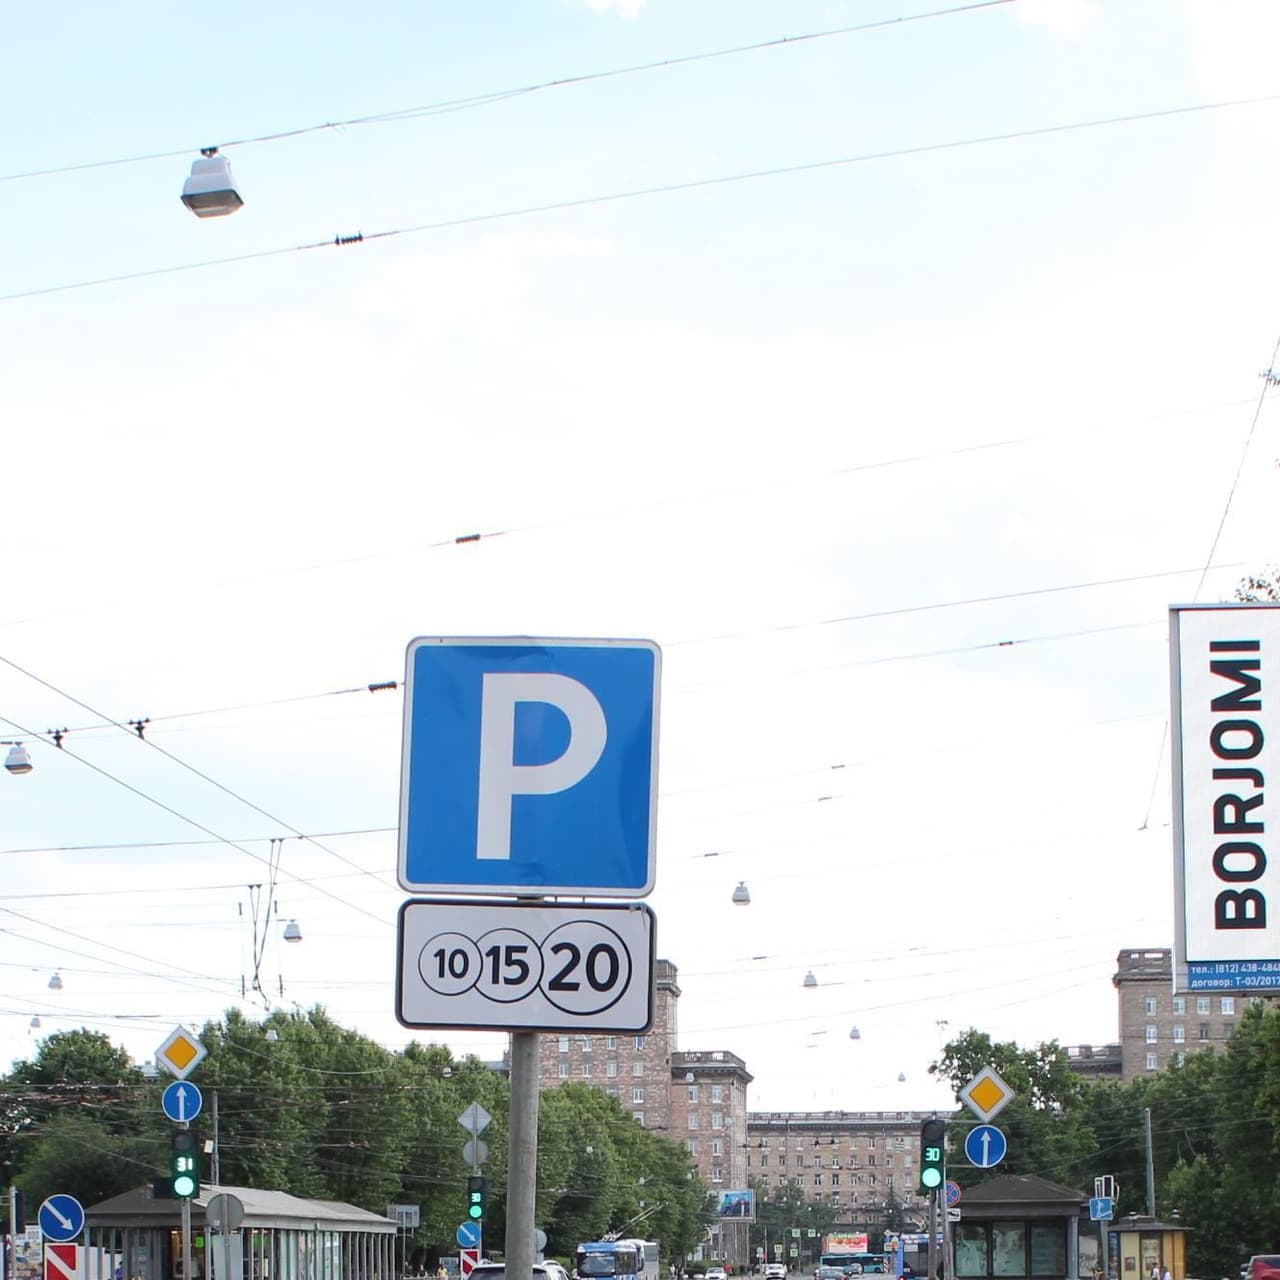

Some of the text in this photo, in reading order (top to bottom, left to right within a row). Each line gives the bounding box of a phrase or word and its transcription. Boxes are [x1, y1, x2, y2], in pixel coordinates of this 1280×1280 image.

[476, 672, 608, 860] P
[1209, 640, 1267, 929] BORJOMI
[433, 942, 620, 992] 10 15 20
[1191, 979, 1233, 989] договор:
[925, 1147, 940, 1161] 30
